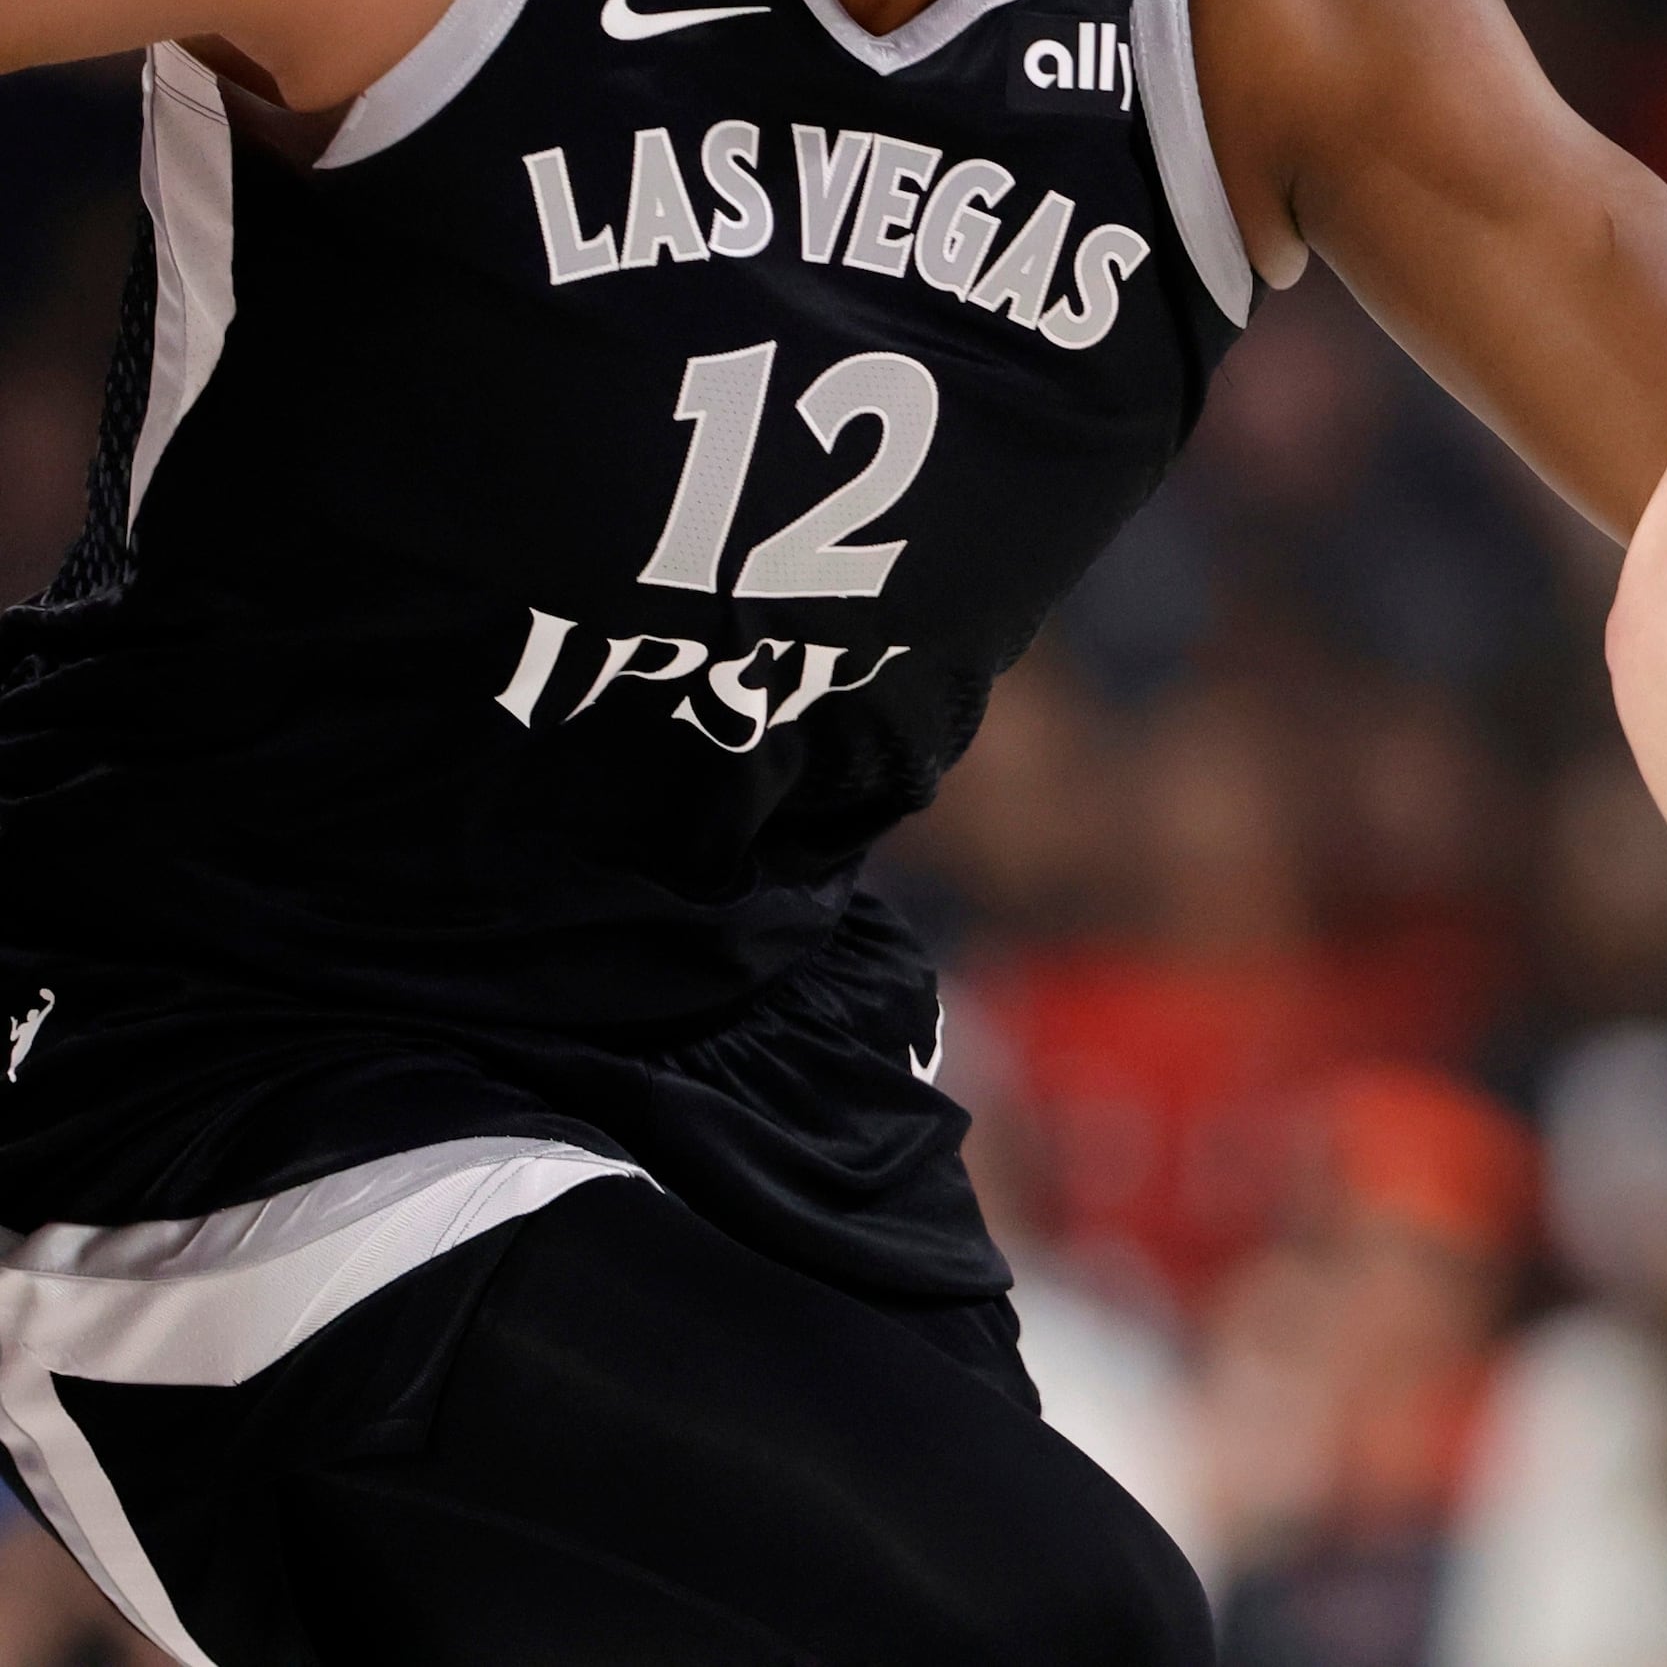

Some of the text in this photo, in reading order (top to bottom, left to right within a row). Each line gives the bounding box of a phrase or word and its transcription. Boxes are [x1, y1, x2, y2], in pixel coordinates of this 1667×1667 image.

[523, 121, 1151, 350] LAS VEGAS
[637, 340, 940, 599] 12
[493, 606, 912, 754] IPSY
